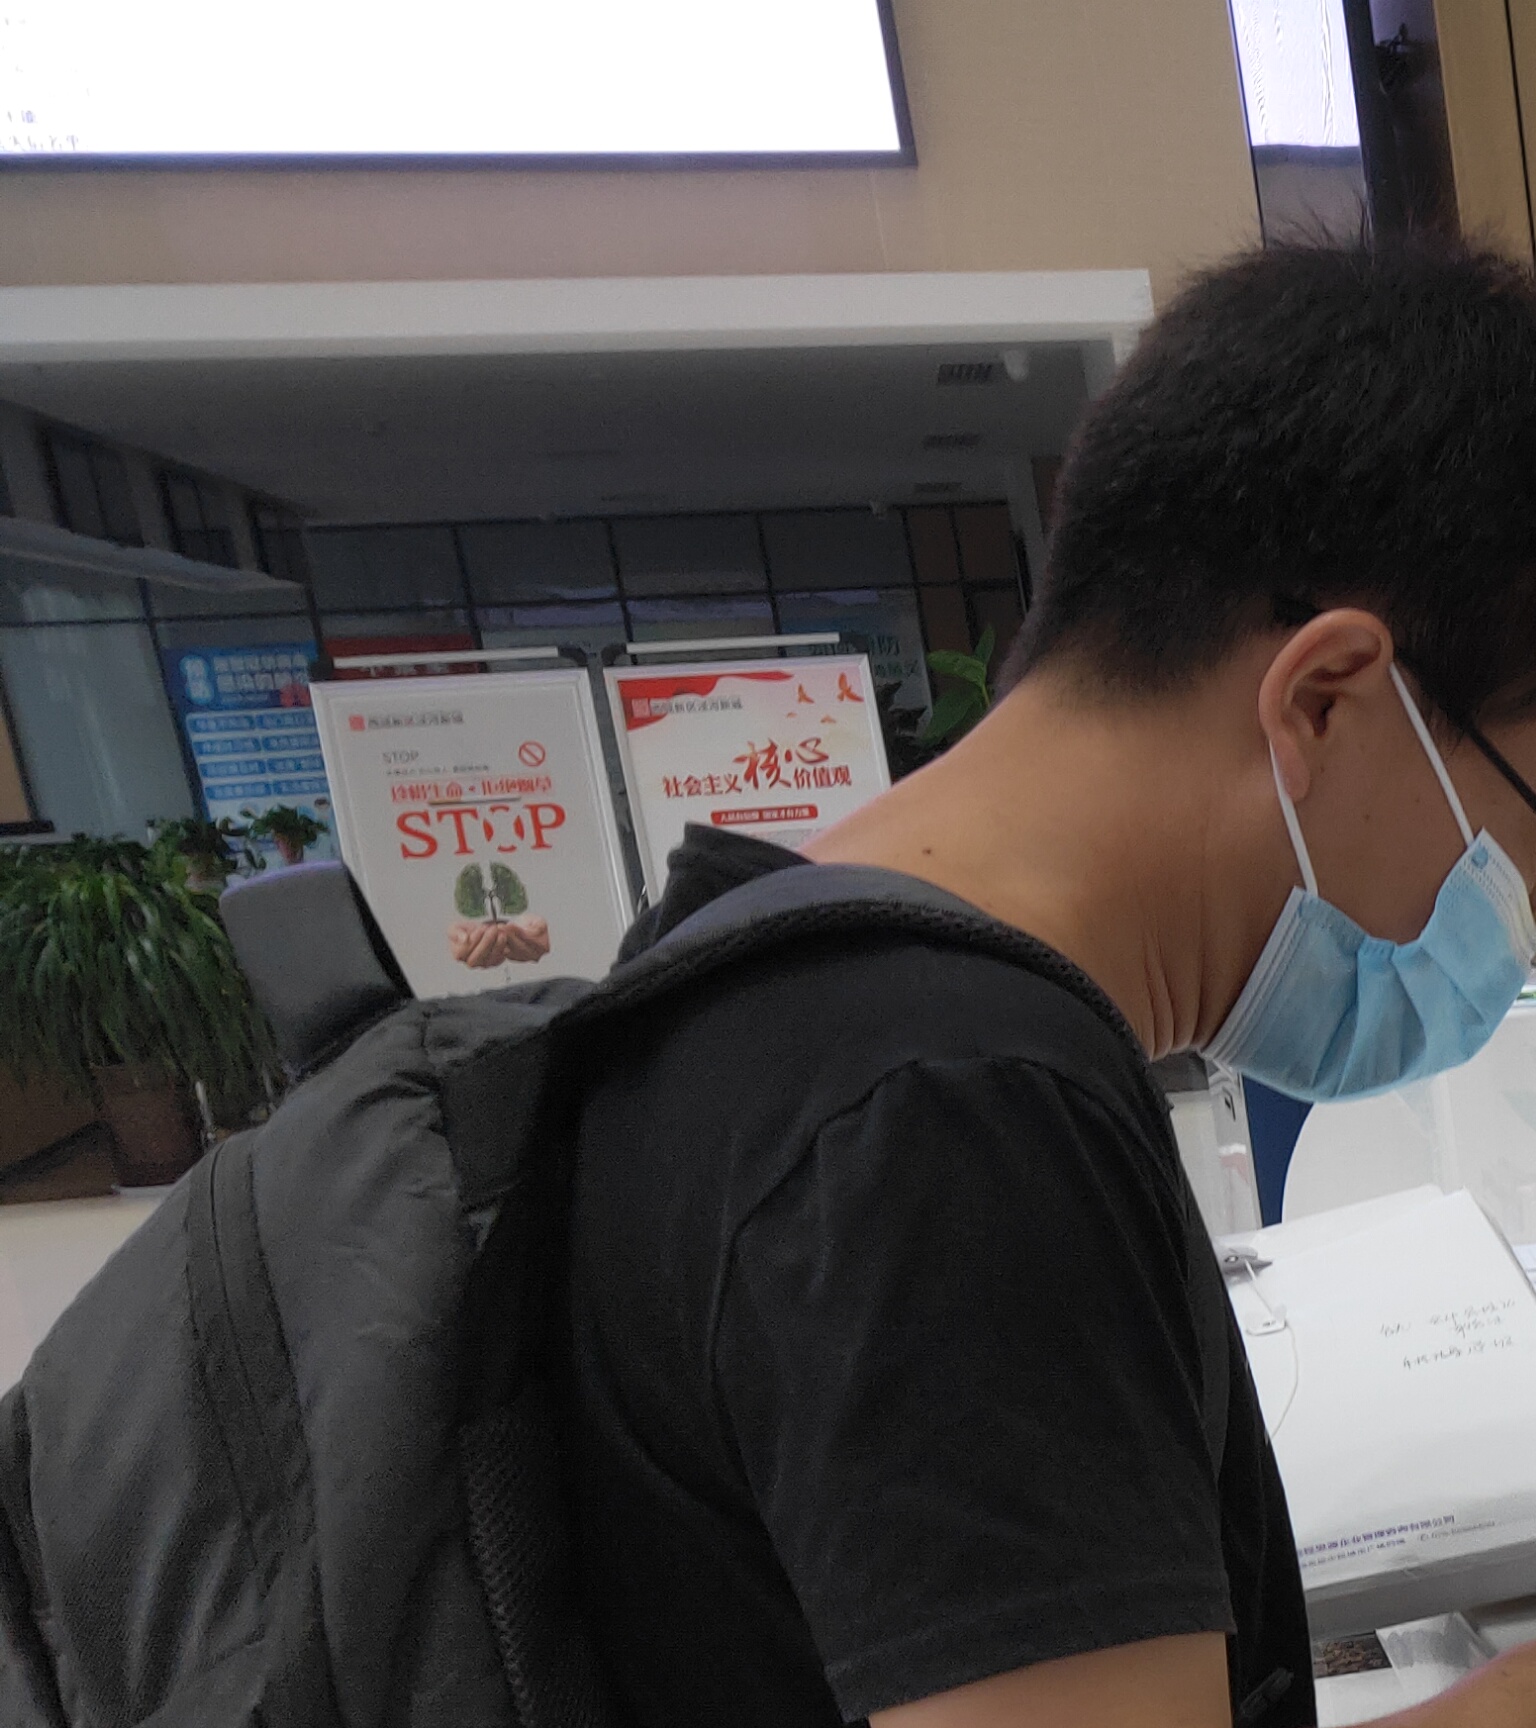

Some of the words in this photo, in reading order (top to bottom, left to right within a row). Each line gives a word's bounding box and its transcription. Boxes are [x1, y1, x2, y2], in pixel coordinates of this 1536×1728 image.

[662, 737, 853, 798] 社会主义核心价值观
[396, 802, 567, 860] STOP
